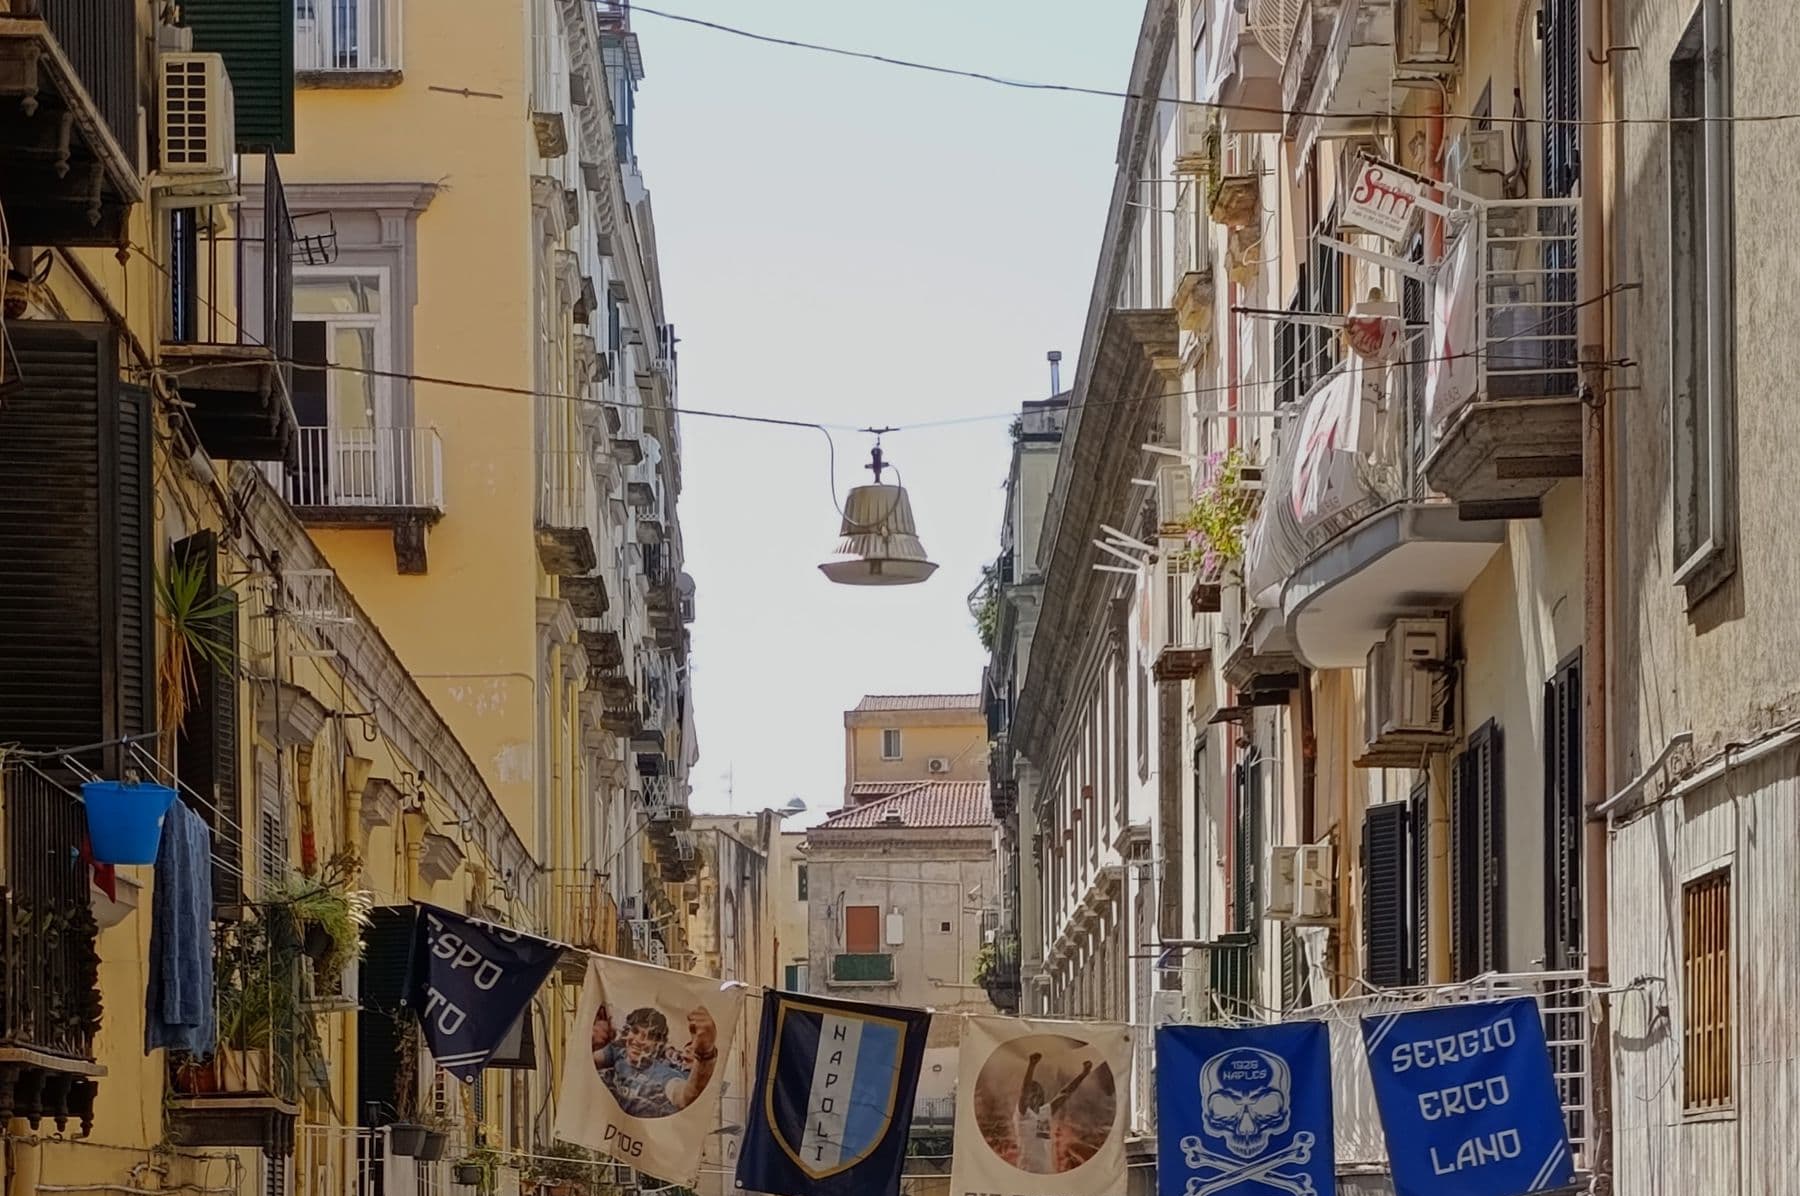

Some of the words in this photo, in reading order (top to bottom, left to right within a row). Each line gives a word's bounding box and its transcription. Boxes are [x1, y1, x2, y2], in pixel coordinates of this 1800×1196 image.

[1231, 1060, 1259, 1070] 1926
[1391, 1017, 1516, 1073] SERGIO
[814, 1024, 847, 1162] NAPOLI
[1223, 1070, 1267, 1080] NAPLES
[1418, 1075, 1510, 1121] ERCO
[1430, 1128, 1521, 1176] LANO
